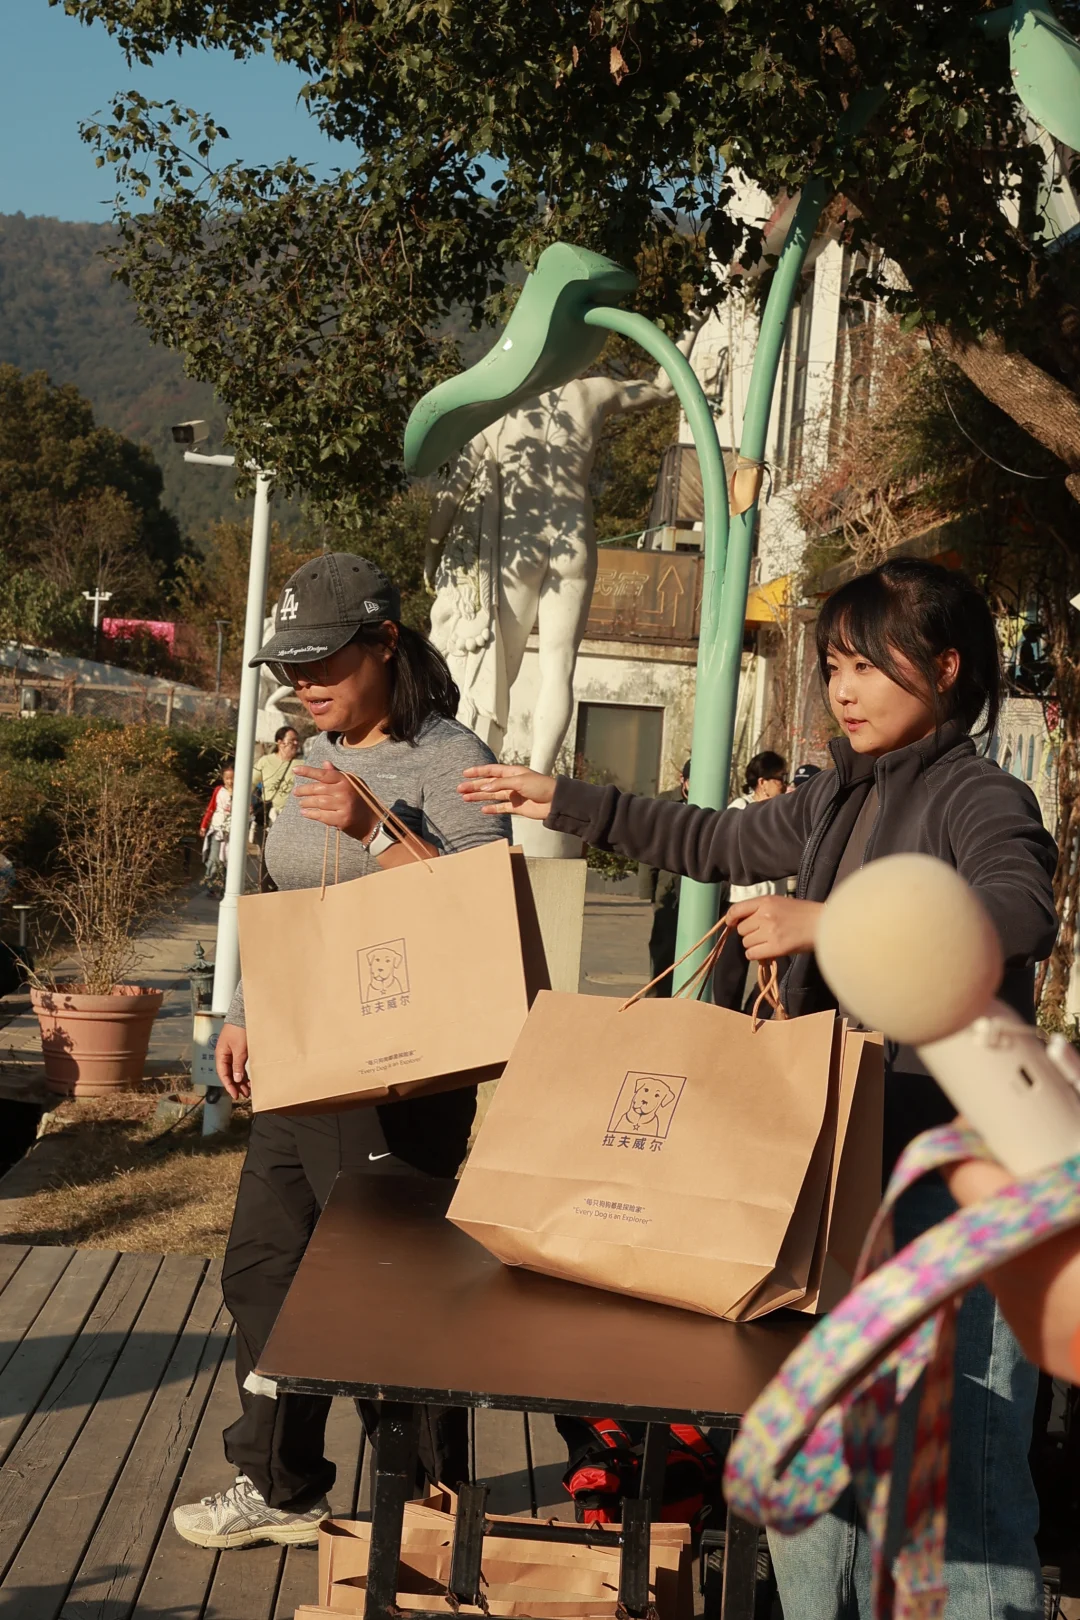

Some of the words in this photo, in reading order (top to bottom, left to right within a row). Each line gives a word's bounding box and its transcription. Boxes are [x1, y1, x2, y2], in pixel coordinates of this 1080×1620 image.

[280, 588, 299, 621] LA
[361, 995, 410, 1016] 拉夫威尔
[602, 1133, 664, 1152] 拉夫威尔
[594, 1209, 608, 1220] Dog
